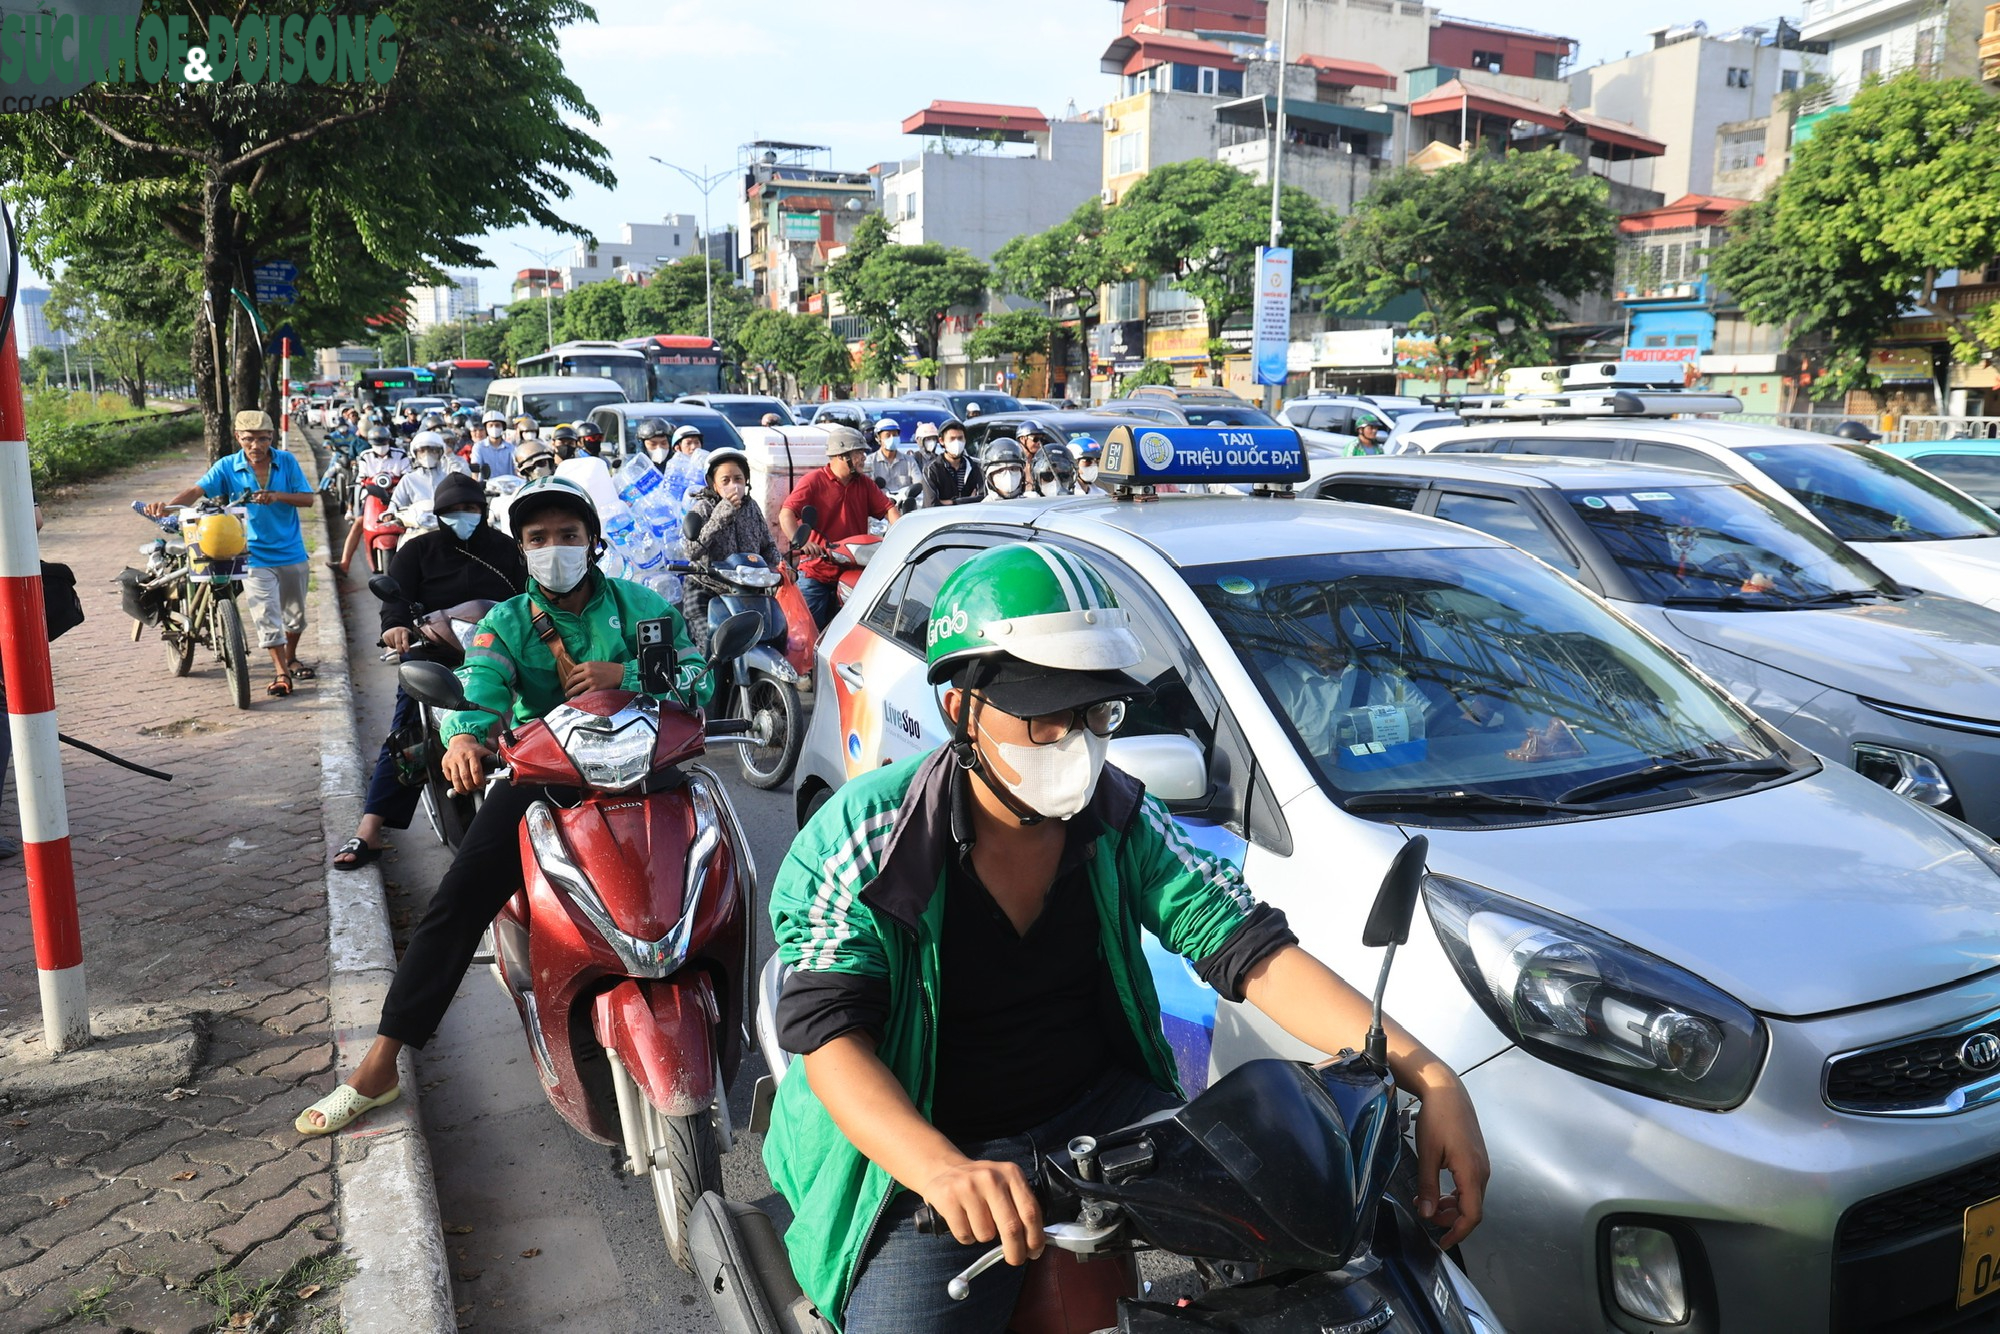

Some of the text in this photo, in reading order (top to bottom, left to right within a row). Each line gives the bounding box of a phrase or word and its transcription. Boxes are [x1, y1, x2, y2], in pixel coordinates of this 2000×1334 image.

[1624, 348, 1697, 362] PHOTOCOPY
[1218, 432, 1254, 446] TAXI
[1176, 445, 1300, 469] TRIỆU QUỐC ĐẠT
[928, 602, 968, 647] Grab
[883, 699, 921, 740] LiveSpo
